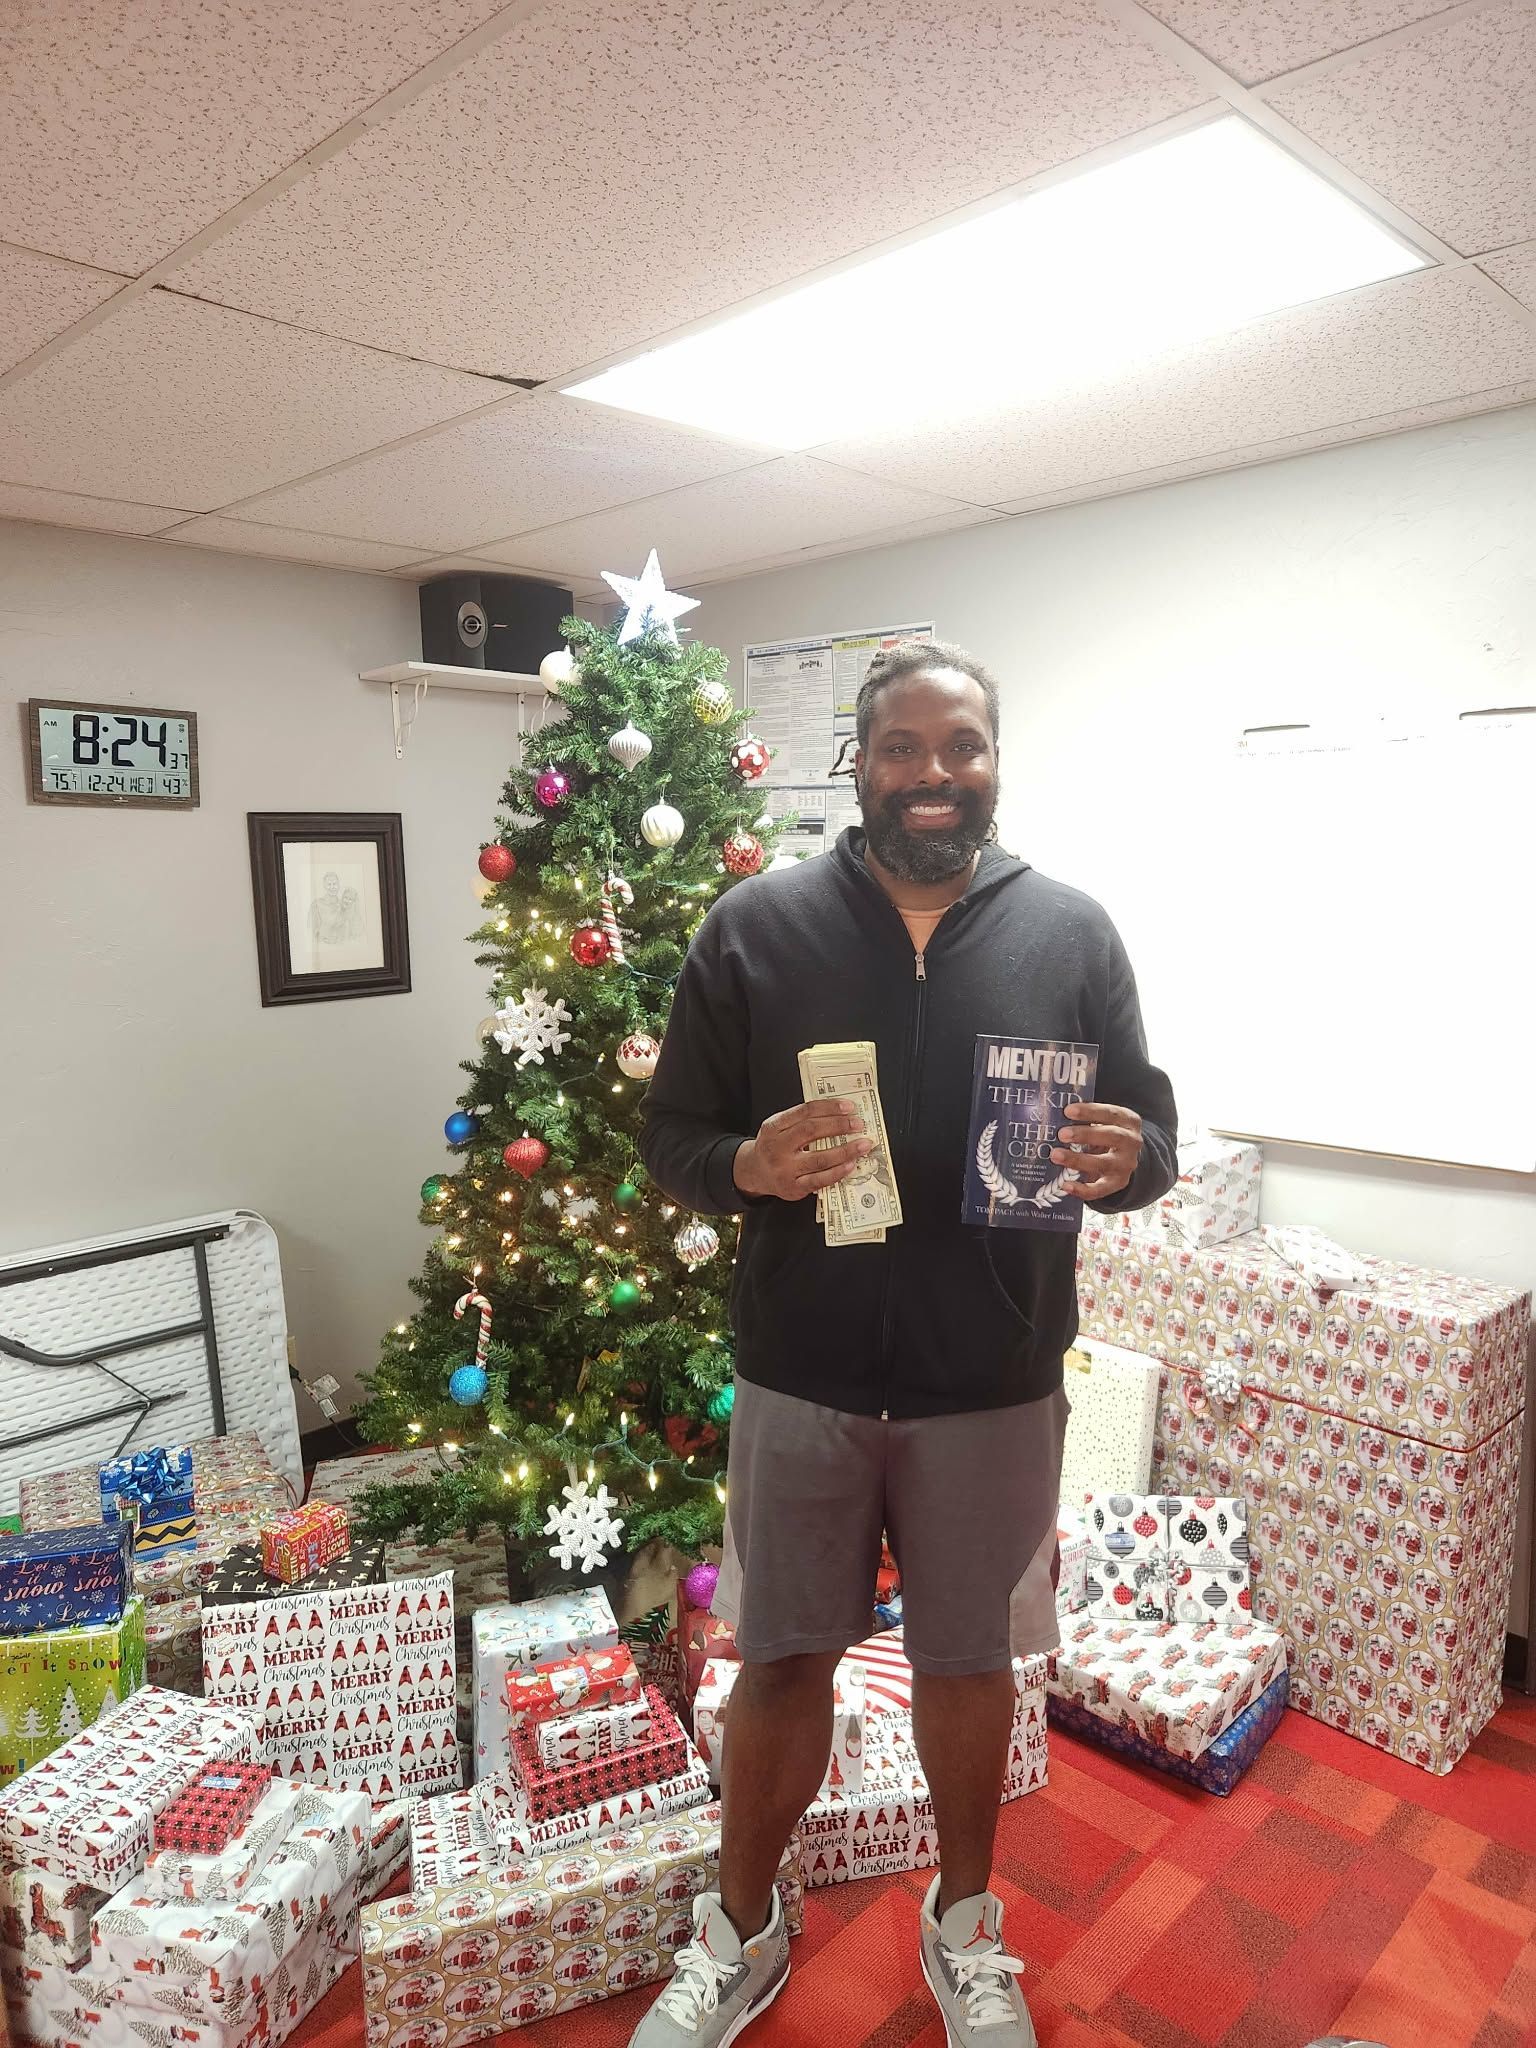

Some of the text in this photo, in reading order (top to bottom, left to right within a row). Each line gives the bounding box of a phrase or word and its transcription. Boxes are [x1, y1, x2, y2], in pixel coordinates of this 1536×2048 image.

[72, 714, 167, 768] 8:24
[170, 753, 188, 770] 37
[130, 777, 153, 794] WED
[986, 1045, 1089, 1087] MENTOR
[988, 1085, 1083, 1109] THE KID
[1029, 1107, 1043, 1121] &
[1008, 1122, 1056, 1141] THE
[1007, 1140, 1053, 1160] CEO
[976, 1205, 994, 1215] TOM
[994, 1207, 1015, 1216] PACE
[1030, 1210, 1051, 1219] Walter
[1052, 1212, 1075, 1221] Jenkins
[15, 1558, 50, 1575] Let
[83, 1549, 119, 1566] Let
[28, 1573, 42, 1586] it
[98, 1563, 112, 1576] it
[4, 1581, 69, 1602] snow
[55, 1602, 92, 1622] Let
[329, 1600, 392, 1621] MERRY
[329, 1615, 391, 1638] Christmas
[395, 1625, 454, 1647] MERRY
[263, 1646, 327, 1668] MERRY
[395, 1641, 454, 1663] Christmas
[263, 1662, 327, 1684] Christmas
[331, 1670, 393, 1692] MERRY
[331, 1687, 393, 1708] Christmas
[397, 1695, 457, 1717] MERRY
[265, 1716, 330, 1741] MERRY
[397, 1710, 457, 1733] Christmas
[265, 1732, 329, 1756] Christmas
[333, 1739, 396, 1763] MERRY
[333, 1756, 394, 1779] Christmas
[399, 1761, 459, 1786] MERRY
[658, 1773, 707, 1801] MERR
[861, 1778, 904, 1794] ERRY
[851, 1790, 908, 1809] Christmas
[529, 1810, 592, 1846] MERRY
[853, 1838, 912, 1861] MERRY
[853, 1854, 910, 1876] Christmas
